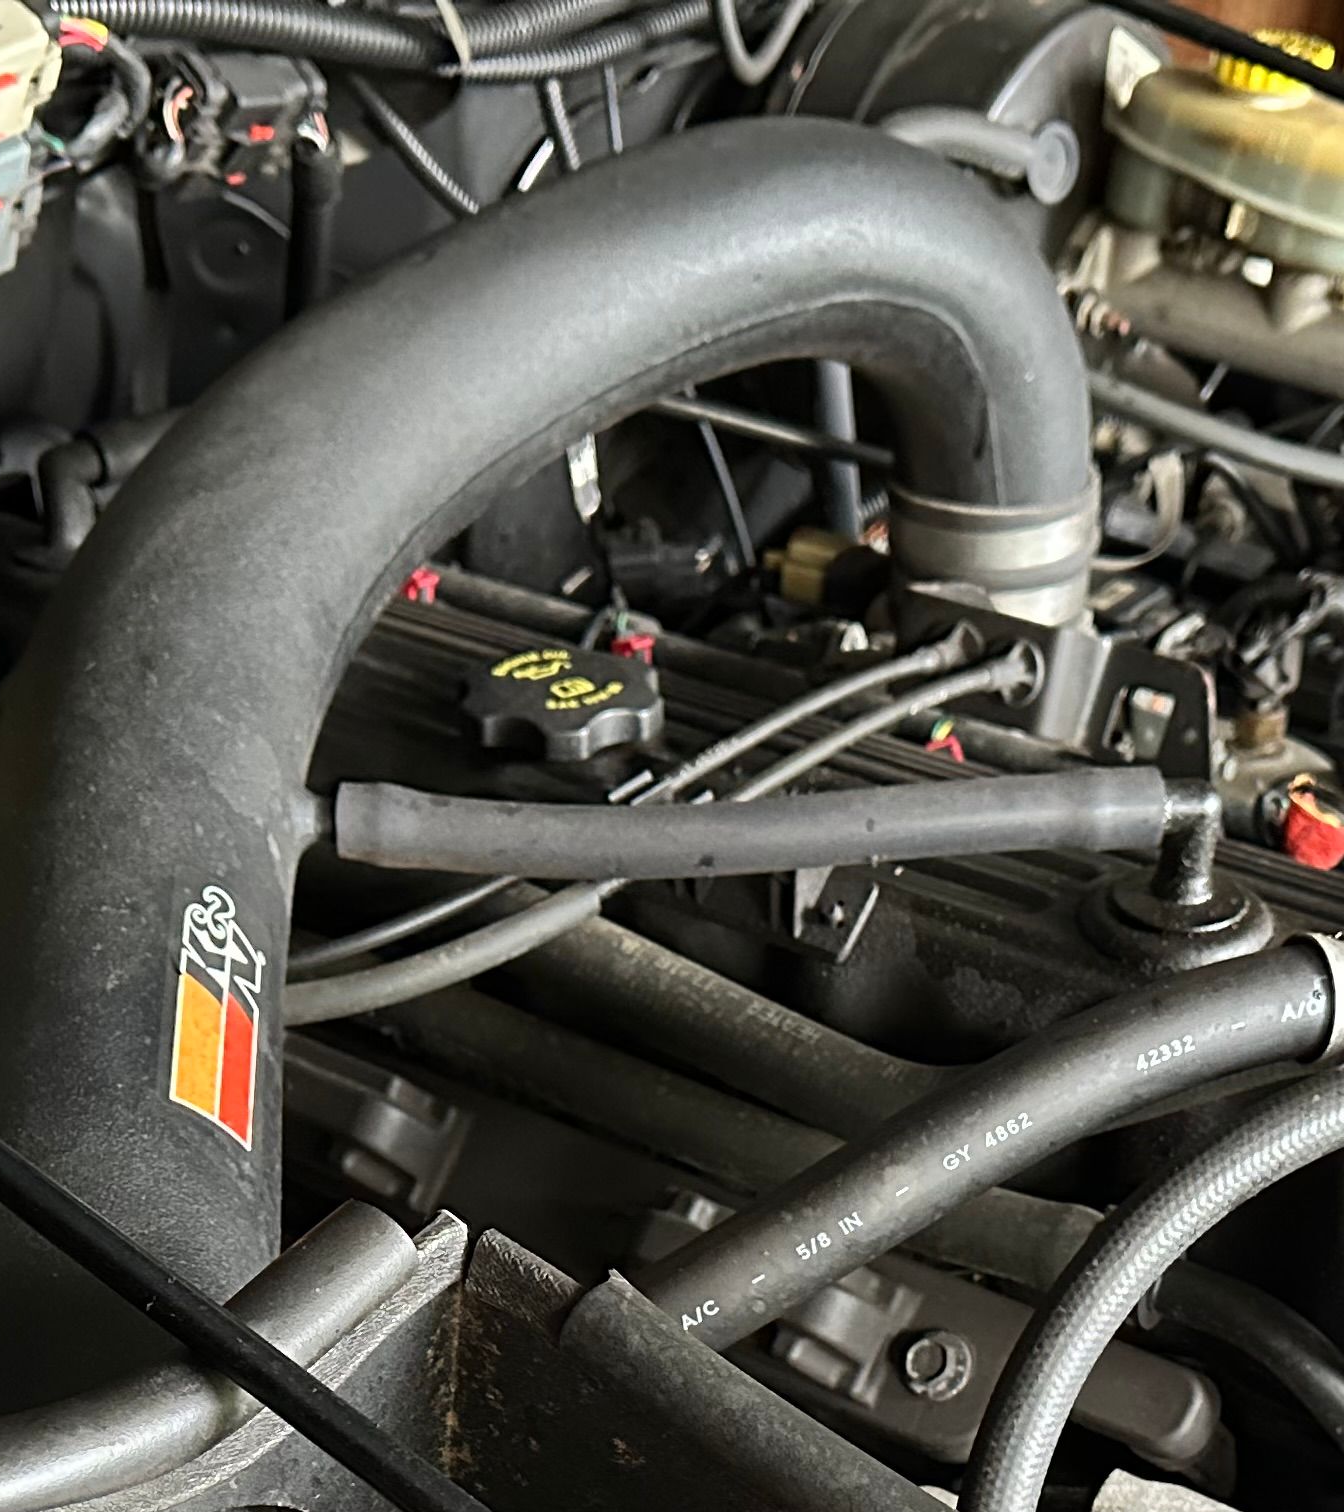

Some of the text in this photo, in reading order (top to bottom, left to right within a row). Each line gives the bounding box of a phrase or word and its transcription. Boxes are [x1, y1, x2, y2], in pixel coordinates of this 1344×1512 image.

[179, 884, 267, 1012] K&N
[676, 1296, 722, 1333] A/C
[793, 1229, 833, 1262] 5/8
[836, 1209, 865, 1236] IN
[939, 1143, 976, 1174] GY
[979, 1108, 1034, 1151] 4862
[1133, 1033, 1196, 1072] 42332
